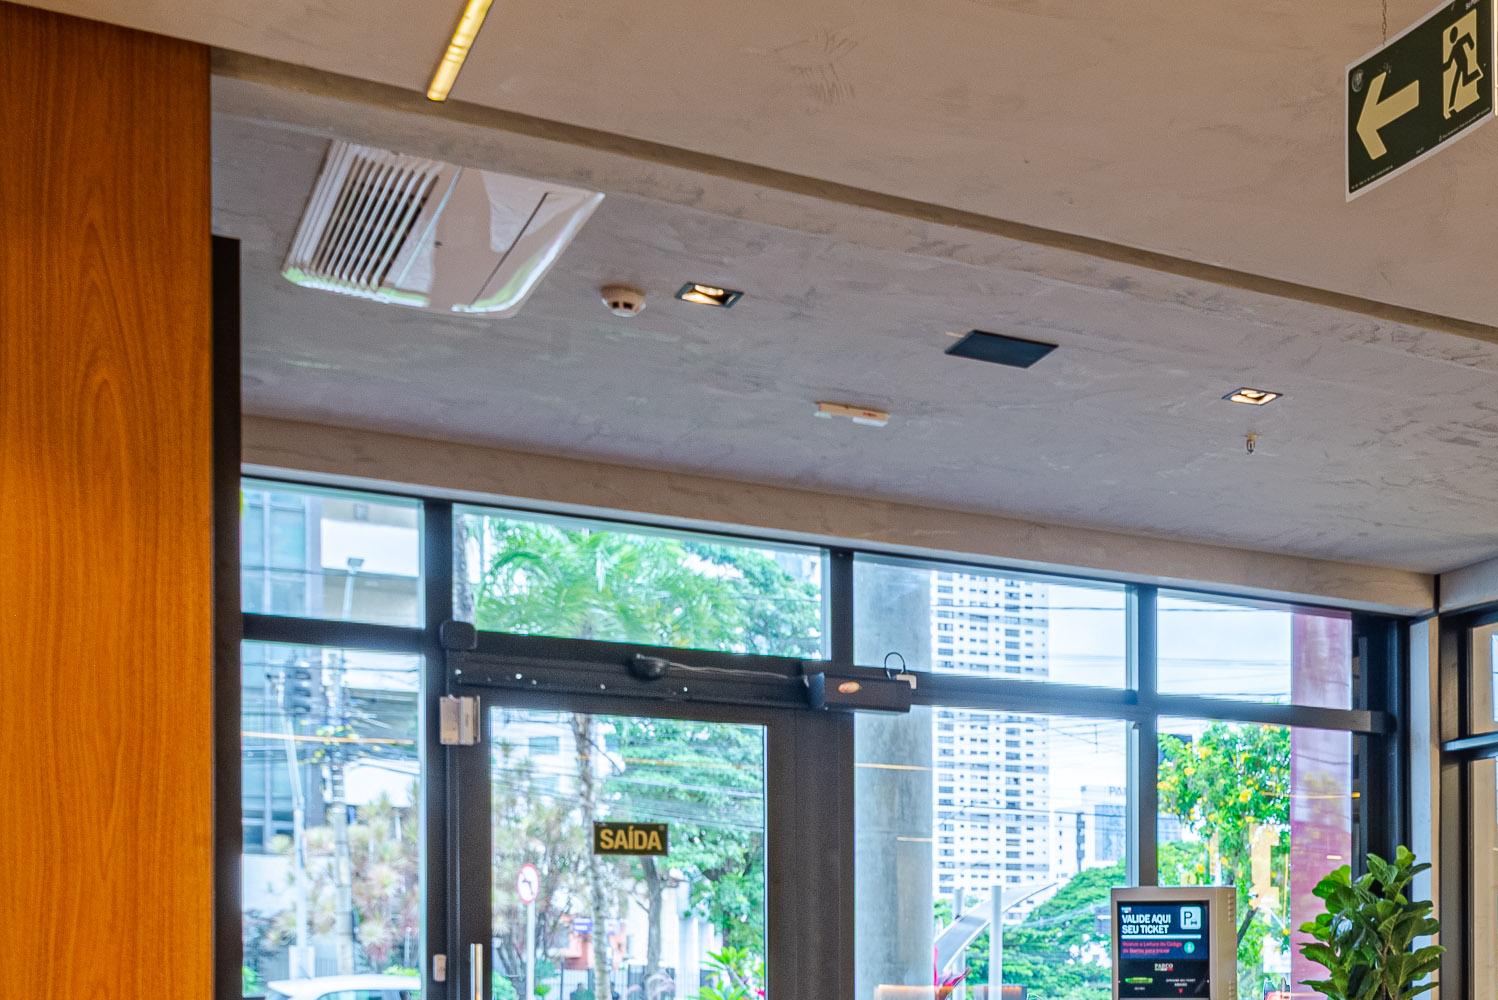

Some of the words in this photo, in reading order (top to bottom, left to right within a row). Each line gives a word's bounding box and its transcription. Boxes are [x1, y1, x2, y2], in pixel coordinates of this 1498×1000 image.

[600, 825, 662, 851] SAÍDA
[1122, 914, 1150, 924] VALIDE
[1151, 914, 1171, 925] AQUI
[1184, 911, 1193, 926] P
[1122, 924, 1139, 934] SEU
[1140, 924, 1169, 934] TICKET
